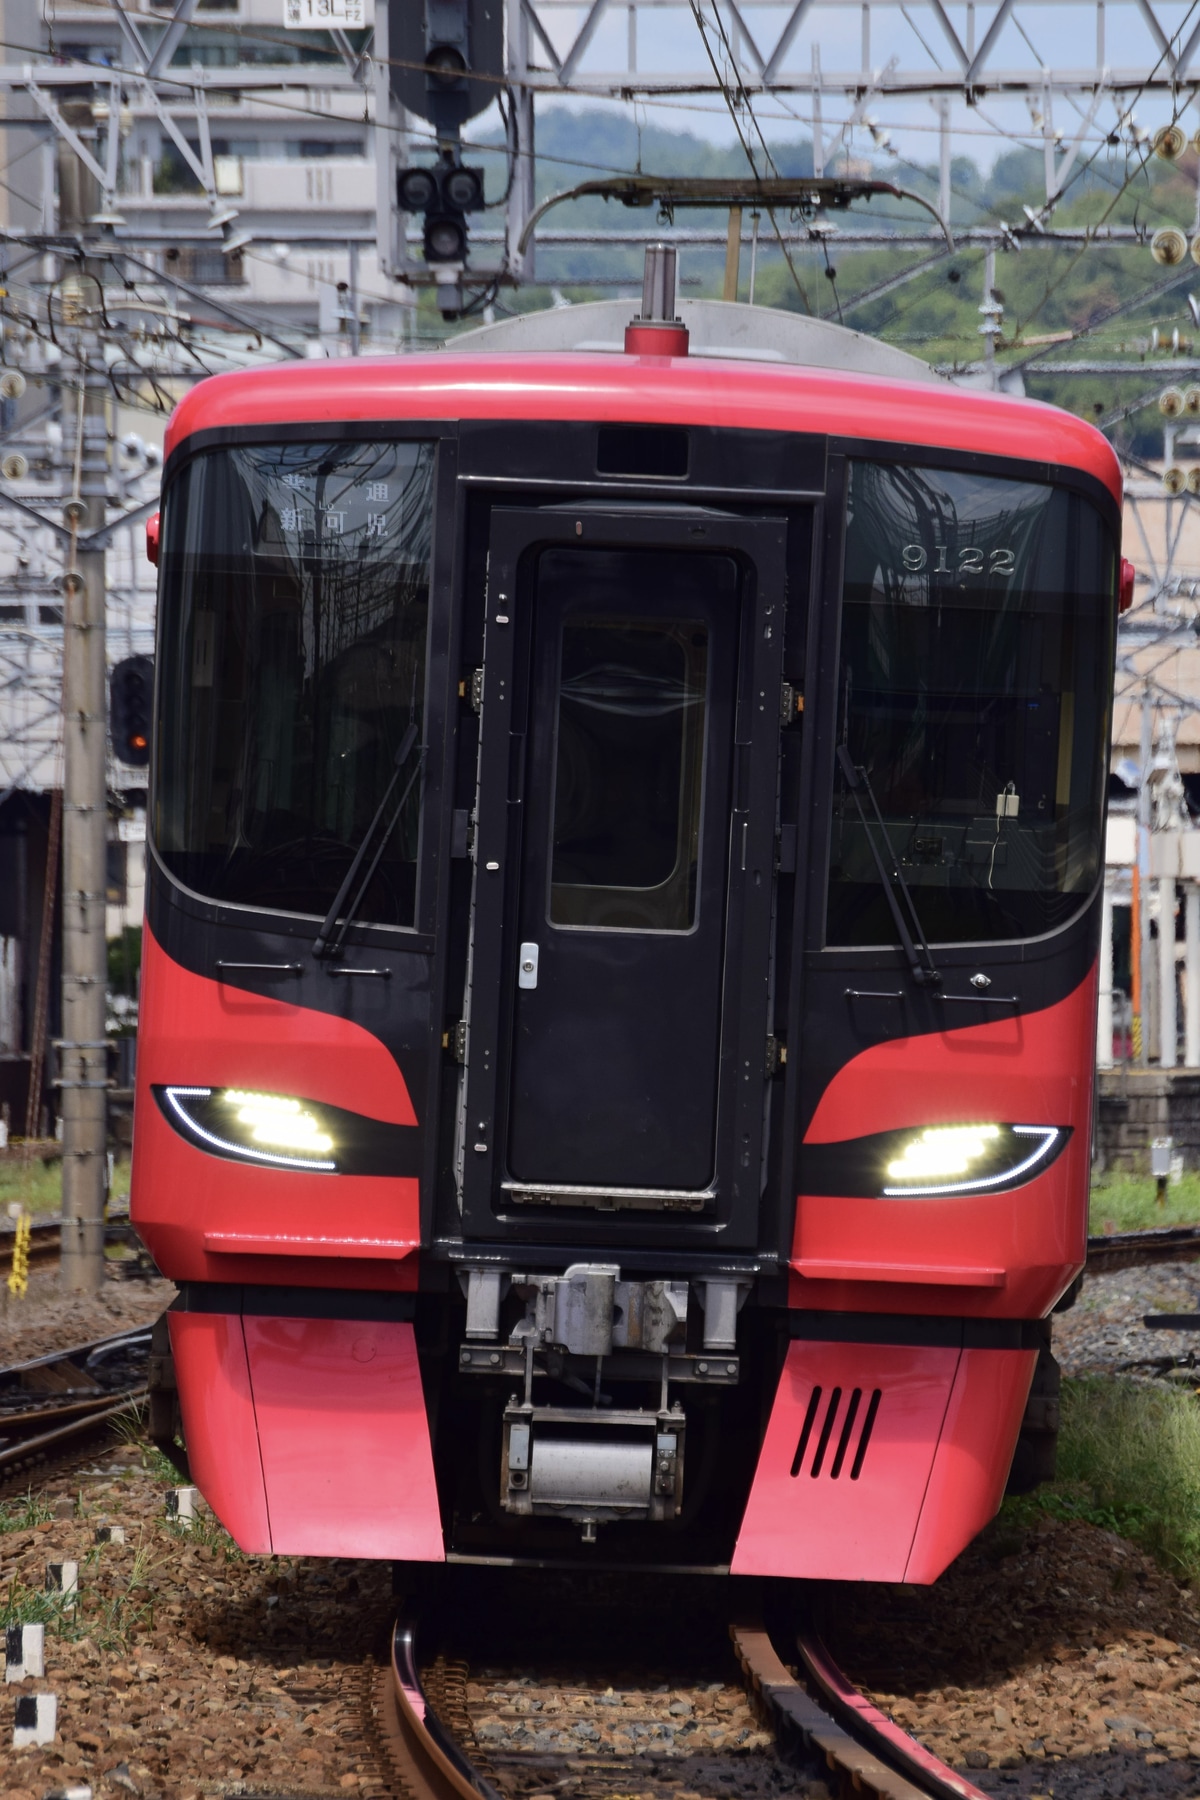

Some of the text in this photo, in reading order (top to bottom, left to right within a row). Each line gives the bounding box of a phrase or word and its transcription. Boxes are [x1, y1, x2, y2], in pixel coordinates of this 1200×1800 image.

[307, 0, 345, 17] 13L
[345, 10, 361, 21] FZ
[281, 508, 388, 536] 新可児
[902, 544, 1015, 576] 9122
